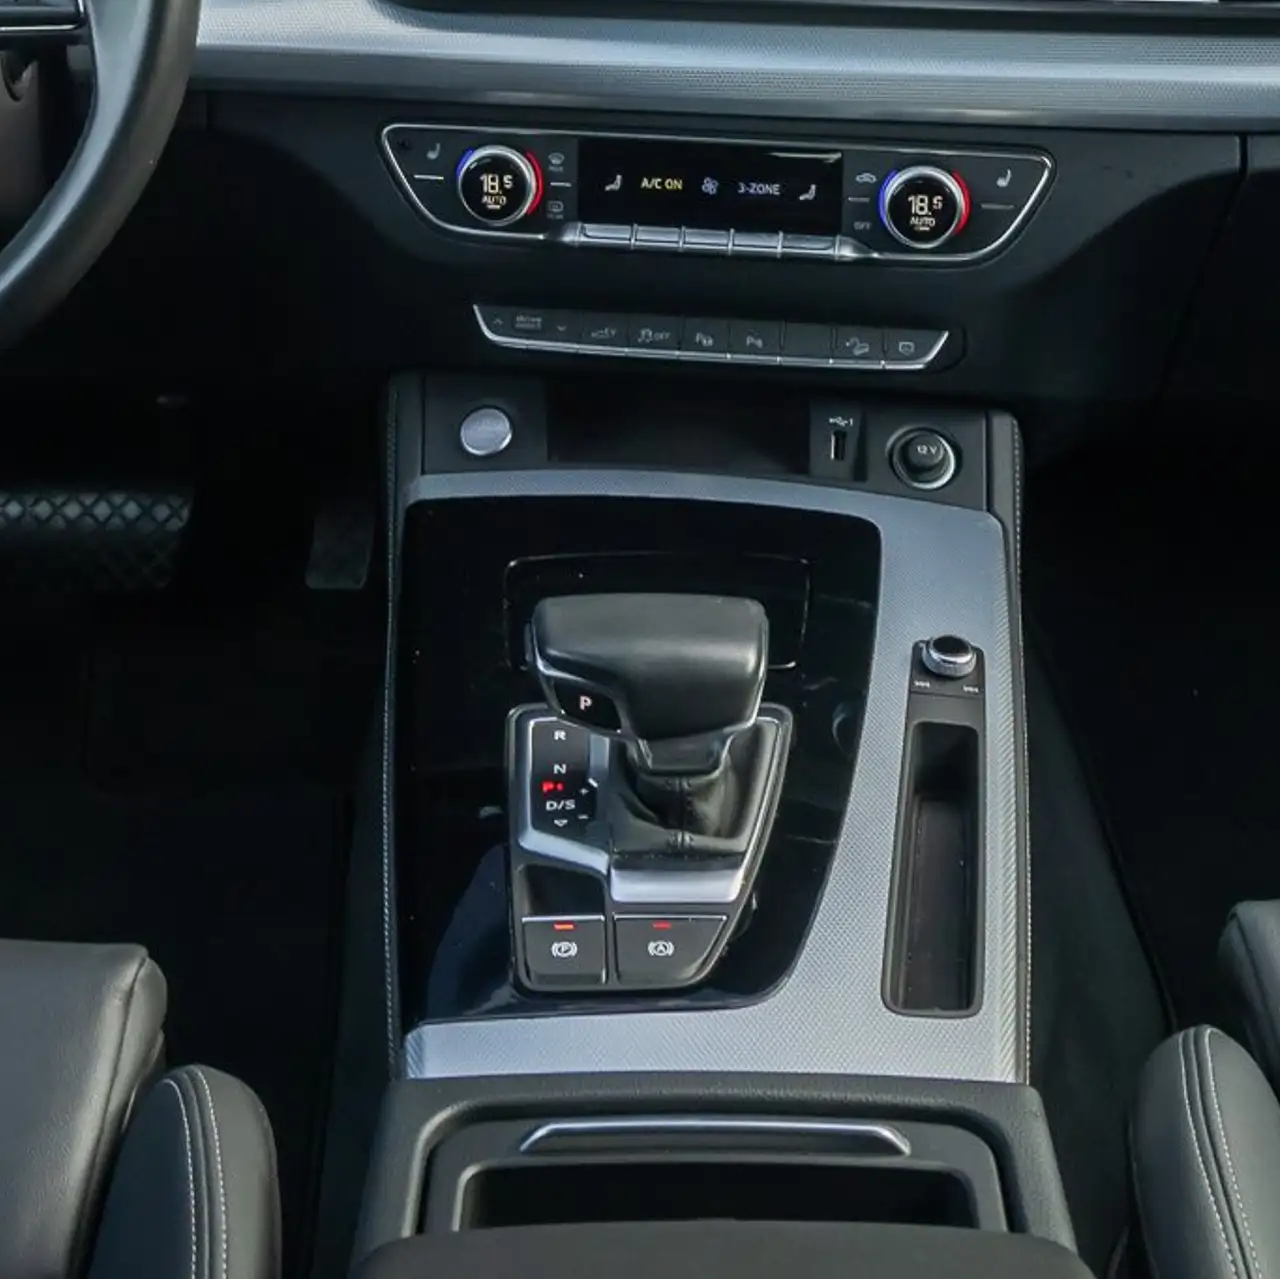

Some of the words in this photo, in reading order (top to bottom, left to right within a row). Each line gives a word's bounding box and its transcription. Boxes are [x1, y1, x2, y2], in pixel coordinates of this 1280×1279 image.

[640, 177, 663, 189] A/C
[665, 178, 683, 190] ON
[737, 182, 781, 195] 3-ZONE
[481, 195, 507, 205] AUTO
[910, 216, 936, 227] AUTO
[580, 696, 592, 710] P
[554, 730, 567, 740] R
[553, 764, 566, 774] N
[546, 799, 576, 811] D/S
